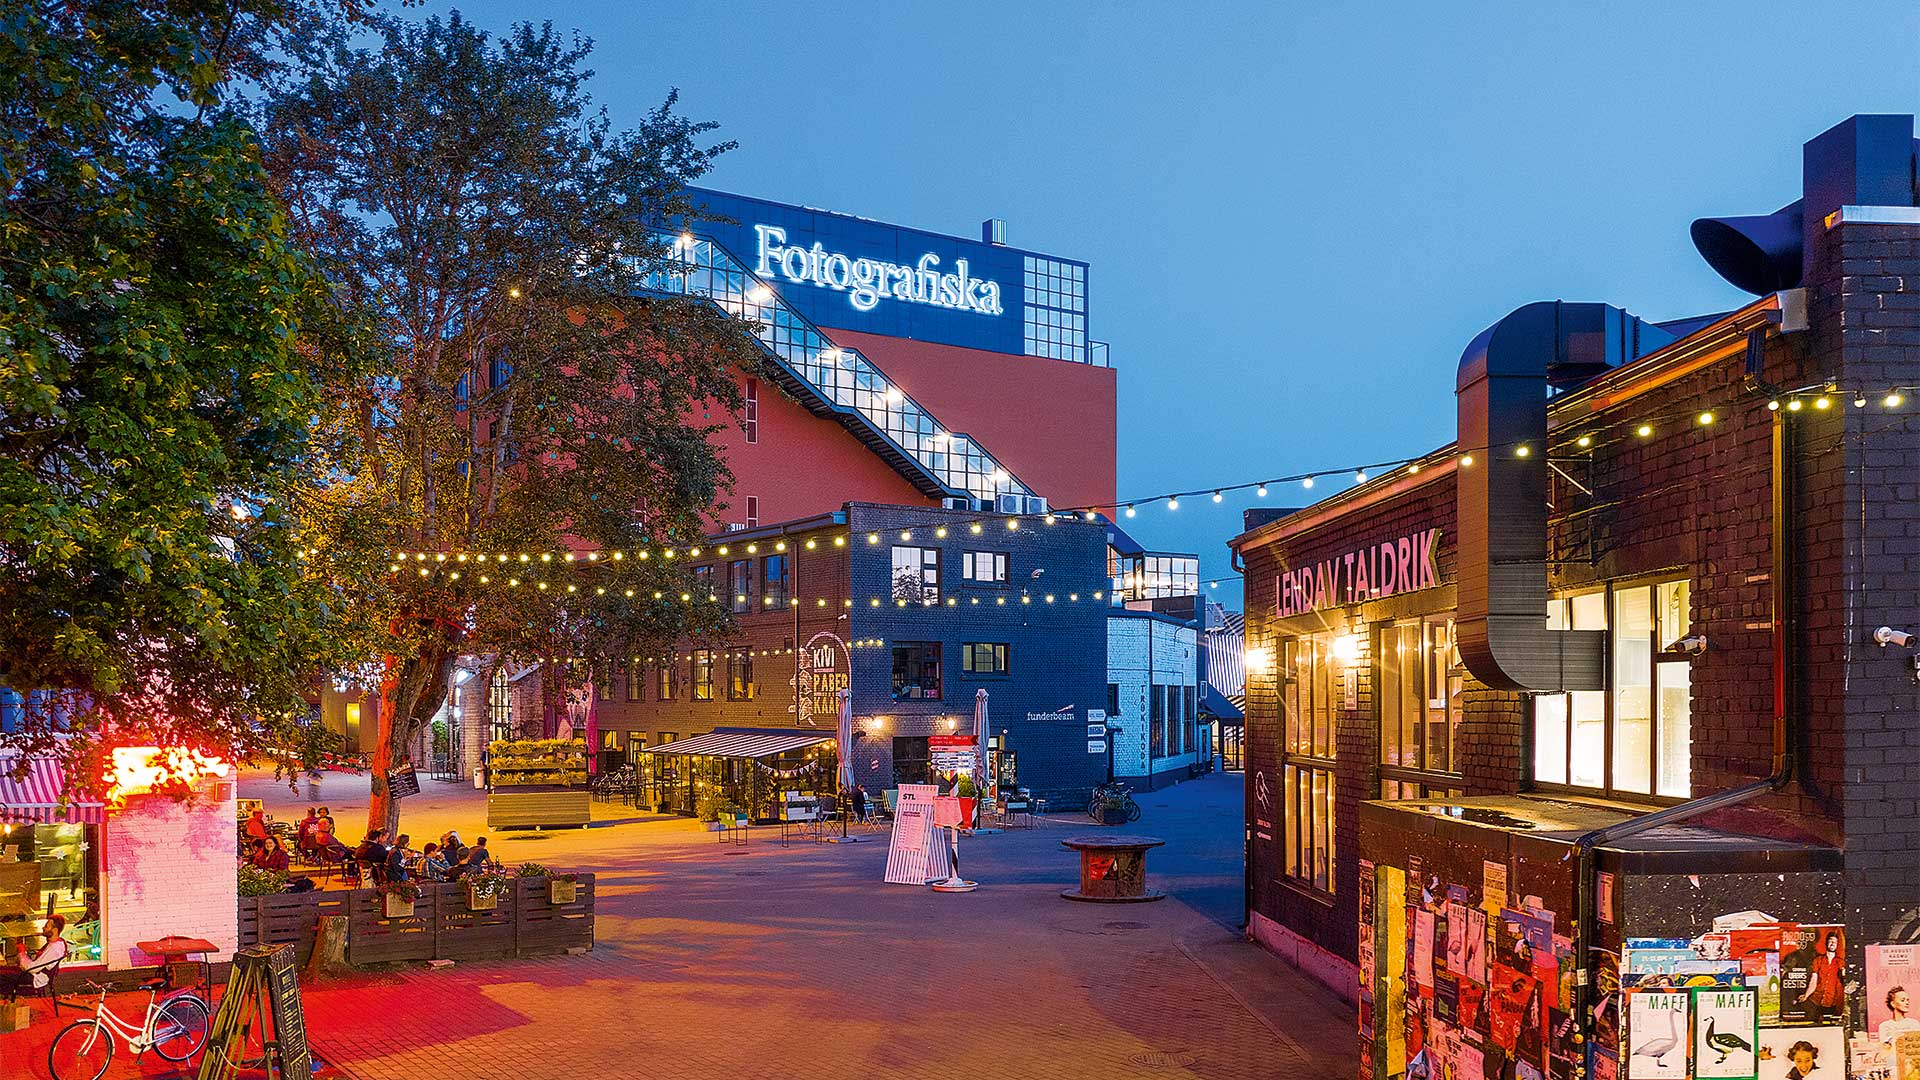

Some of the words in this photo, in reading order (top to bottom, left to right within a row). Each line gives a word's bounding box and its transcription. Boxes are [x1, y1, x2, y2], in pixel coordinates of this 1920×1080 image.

[755, 224, 1003, 315] Fotografiska
[1276, 557, 1341, 618] LENDAV
[1344, 528, 1441, 604] TALDRIK
[813, 647, 835, 668] KIVI
[813, 673, 849, 692] PABER
[1026, 711, 1075, 721] funderbeam
[1648, 995, 1685, 1009] MAFF
[1715, 994, 1751, 1008] MAFF
